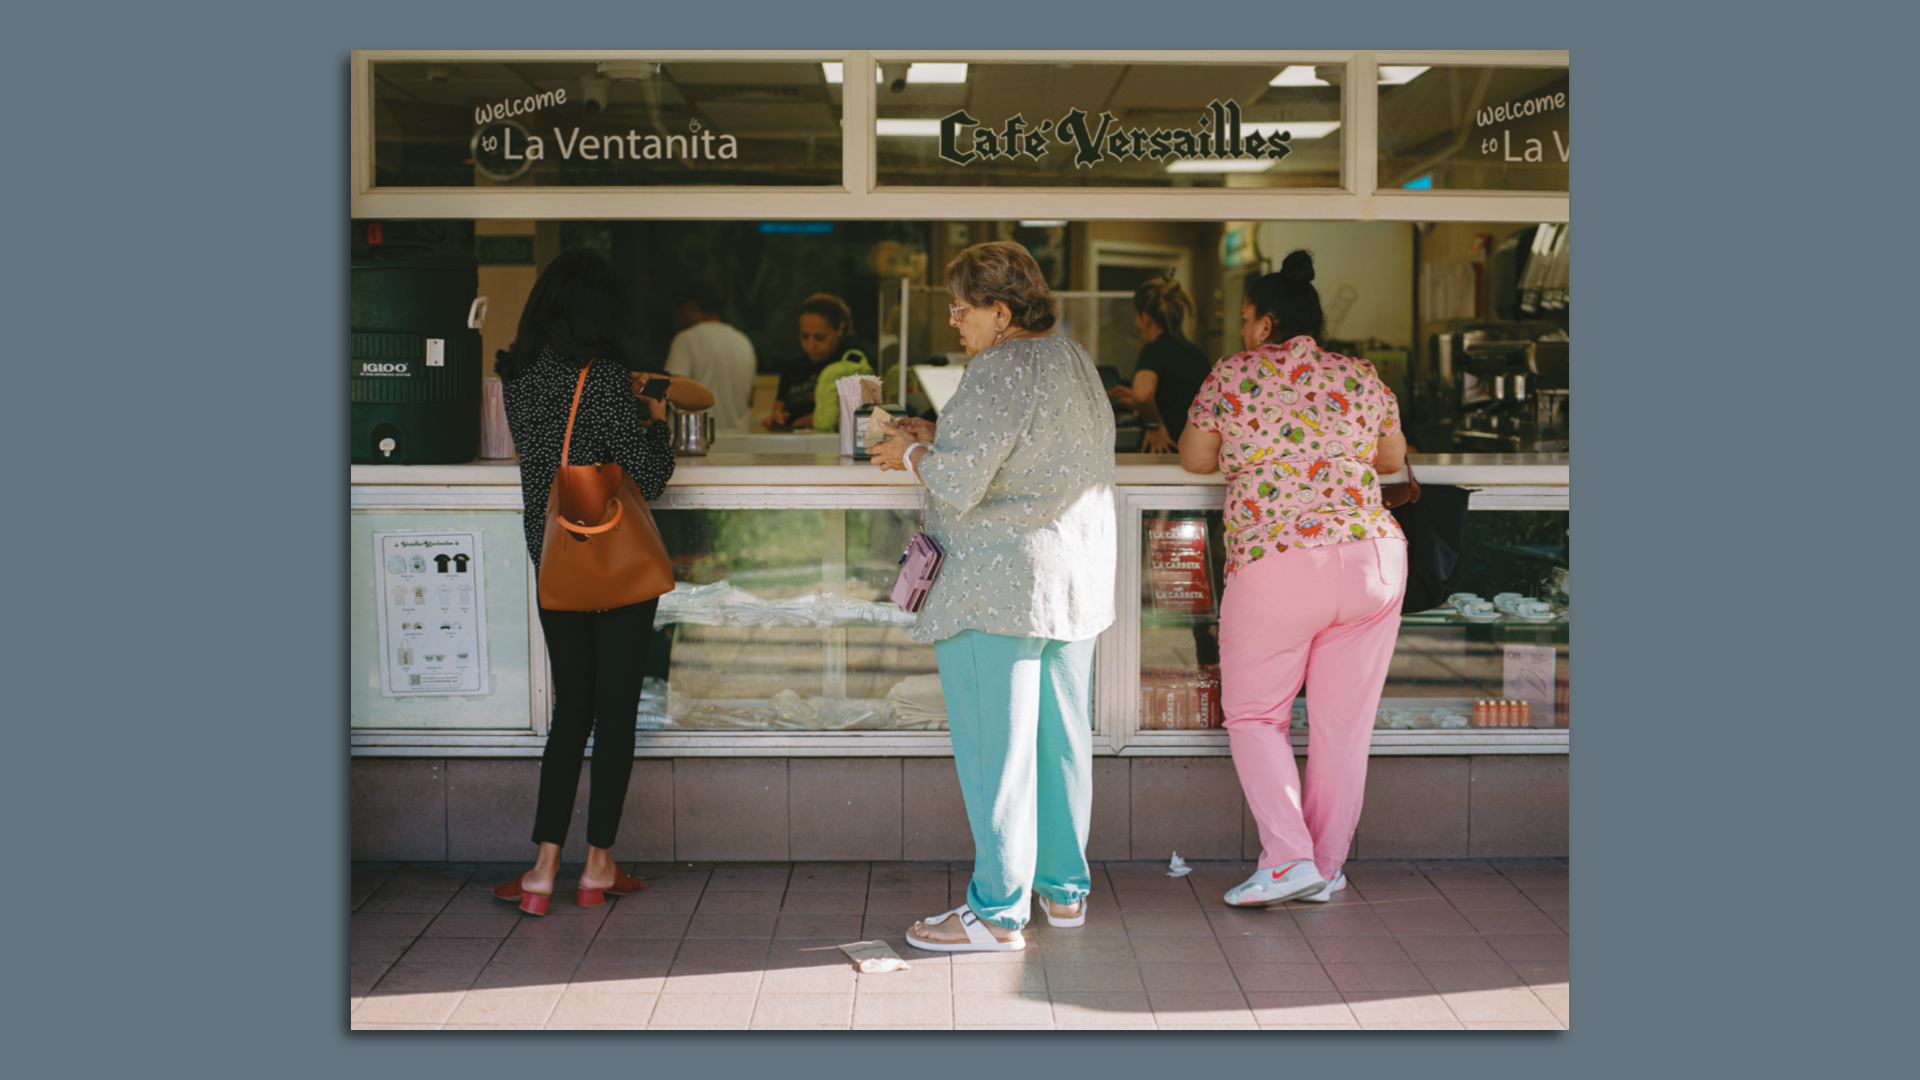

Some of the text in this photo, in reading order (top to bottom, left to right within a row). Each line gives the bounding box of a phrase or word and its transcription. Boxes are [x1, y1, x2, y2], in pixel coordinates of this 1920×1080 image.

[475, 88, 567, 125] Welcome
[1476, 92, 1566, 127] Welcome
[482, 119, 738, 160] to La Ventanita
[938, 98, 1293, 169] Café Versailles
[1481, 138, 1498, 154] to
[1504, 130, 1543, 162] La
[363, 363, 407, 372] IGLOO
[1166, 692, 1174, 728] CARRETA
[1200, 692, 1208, 728] CARRETA
